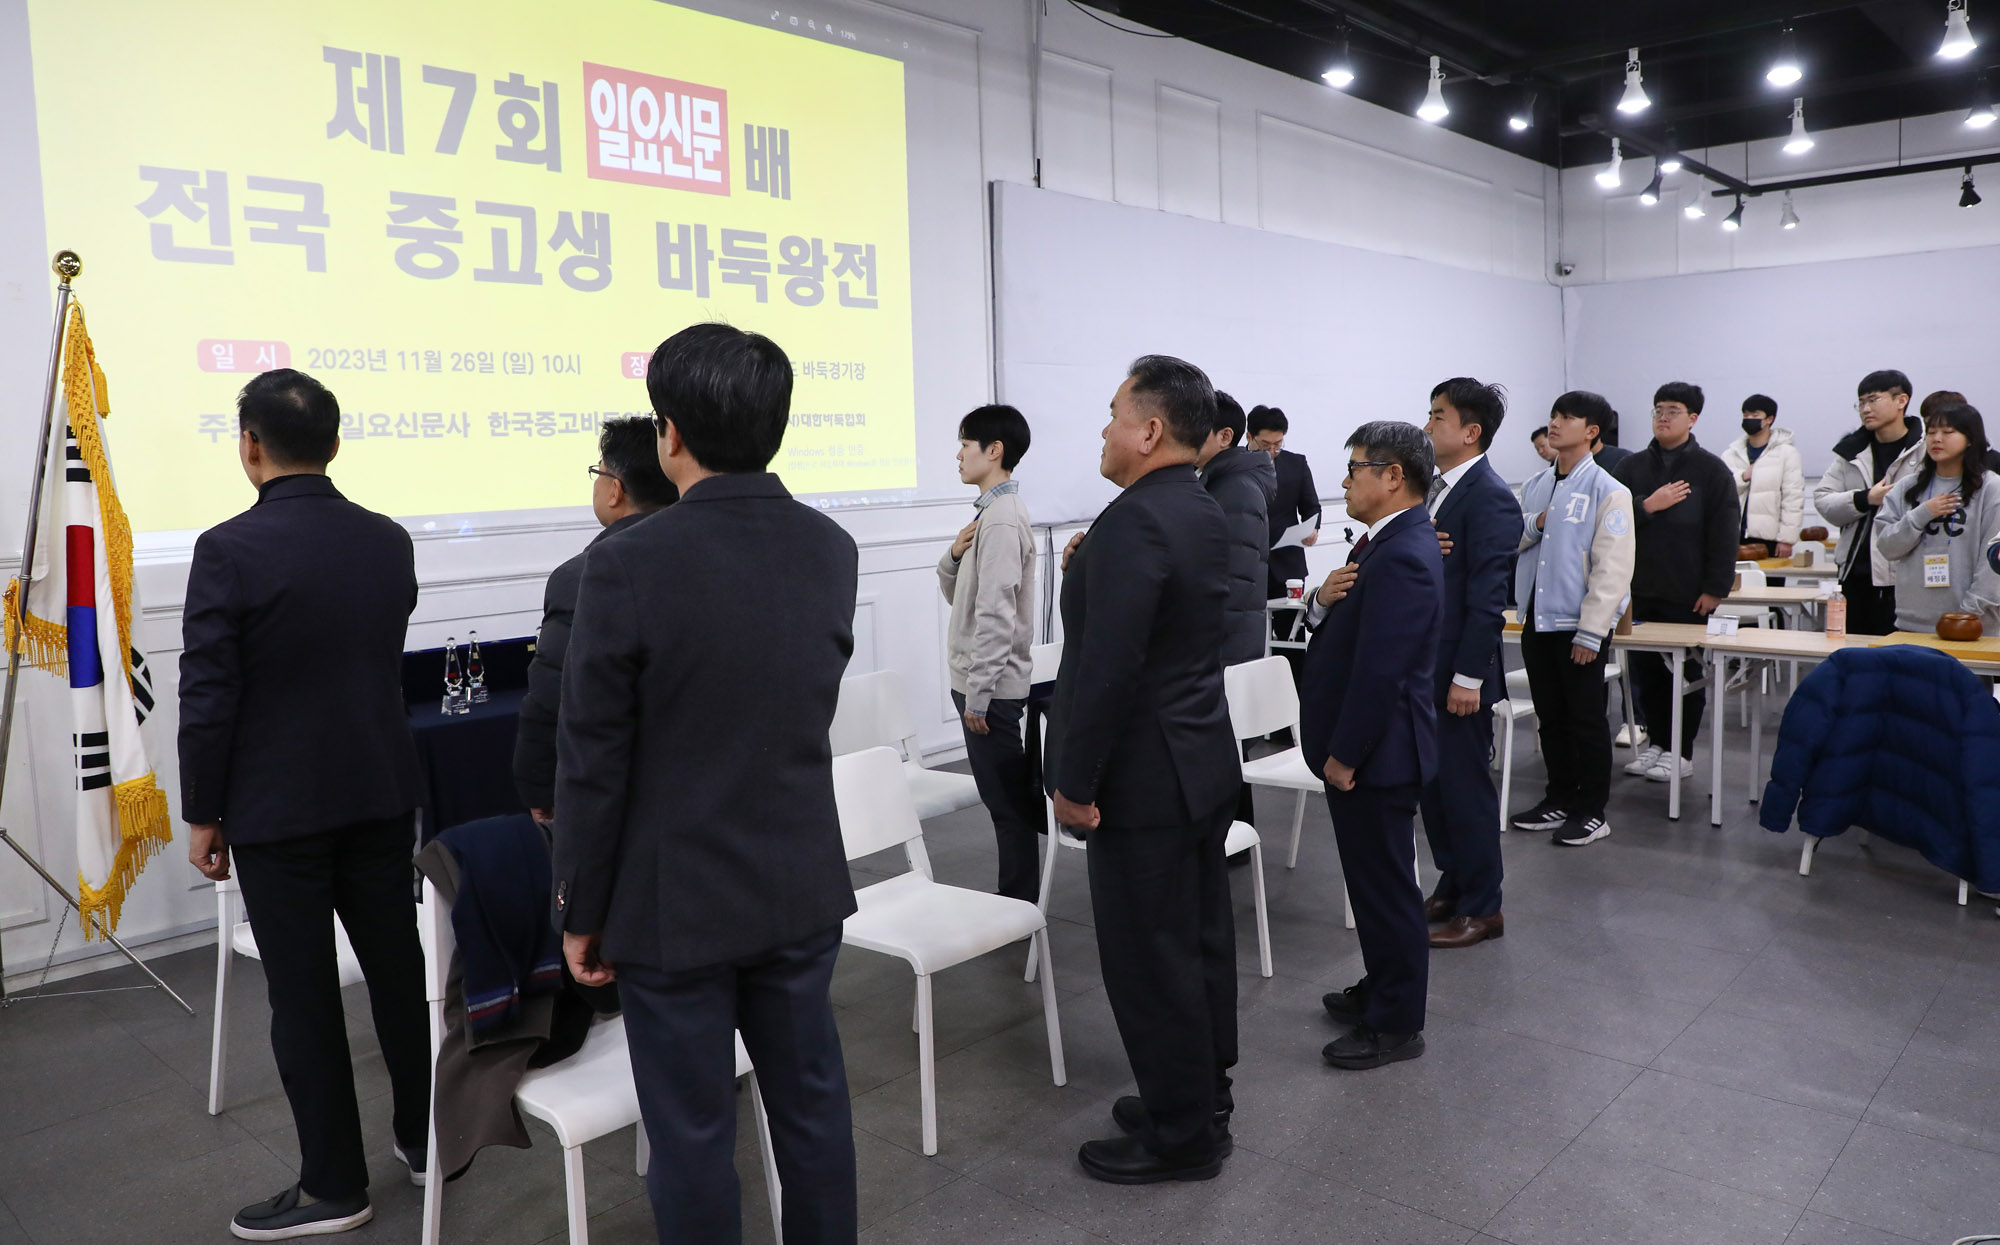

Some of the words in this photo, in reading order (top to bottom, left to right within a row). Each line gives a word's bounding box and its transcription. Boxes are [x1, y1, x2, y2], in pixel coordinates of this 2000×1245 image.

[590, 78, 722, 183] 일요신문
[744, 123, 791, 201] 배
[134, 164, 331, 273] 전국
[386, 189, 614, 292] 중고생
[655, 222, 880, 310] 바둑왕전
[307, 347, 388, 373] 2023년
[397, 349, 443, 373] 11월
[450, 351, 495, 374] 26일
[502, 351, 534, 376] (일)
[542, 353, 582, 375] 10시
[802, 360, 866, 381] 바둑경기장
[198, 413, 240, 443] 주
[340, 411, 471, 441] 일요신문사
[787, 446, 824, 457] Windows
